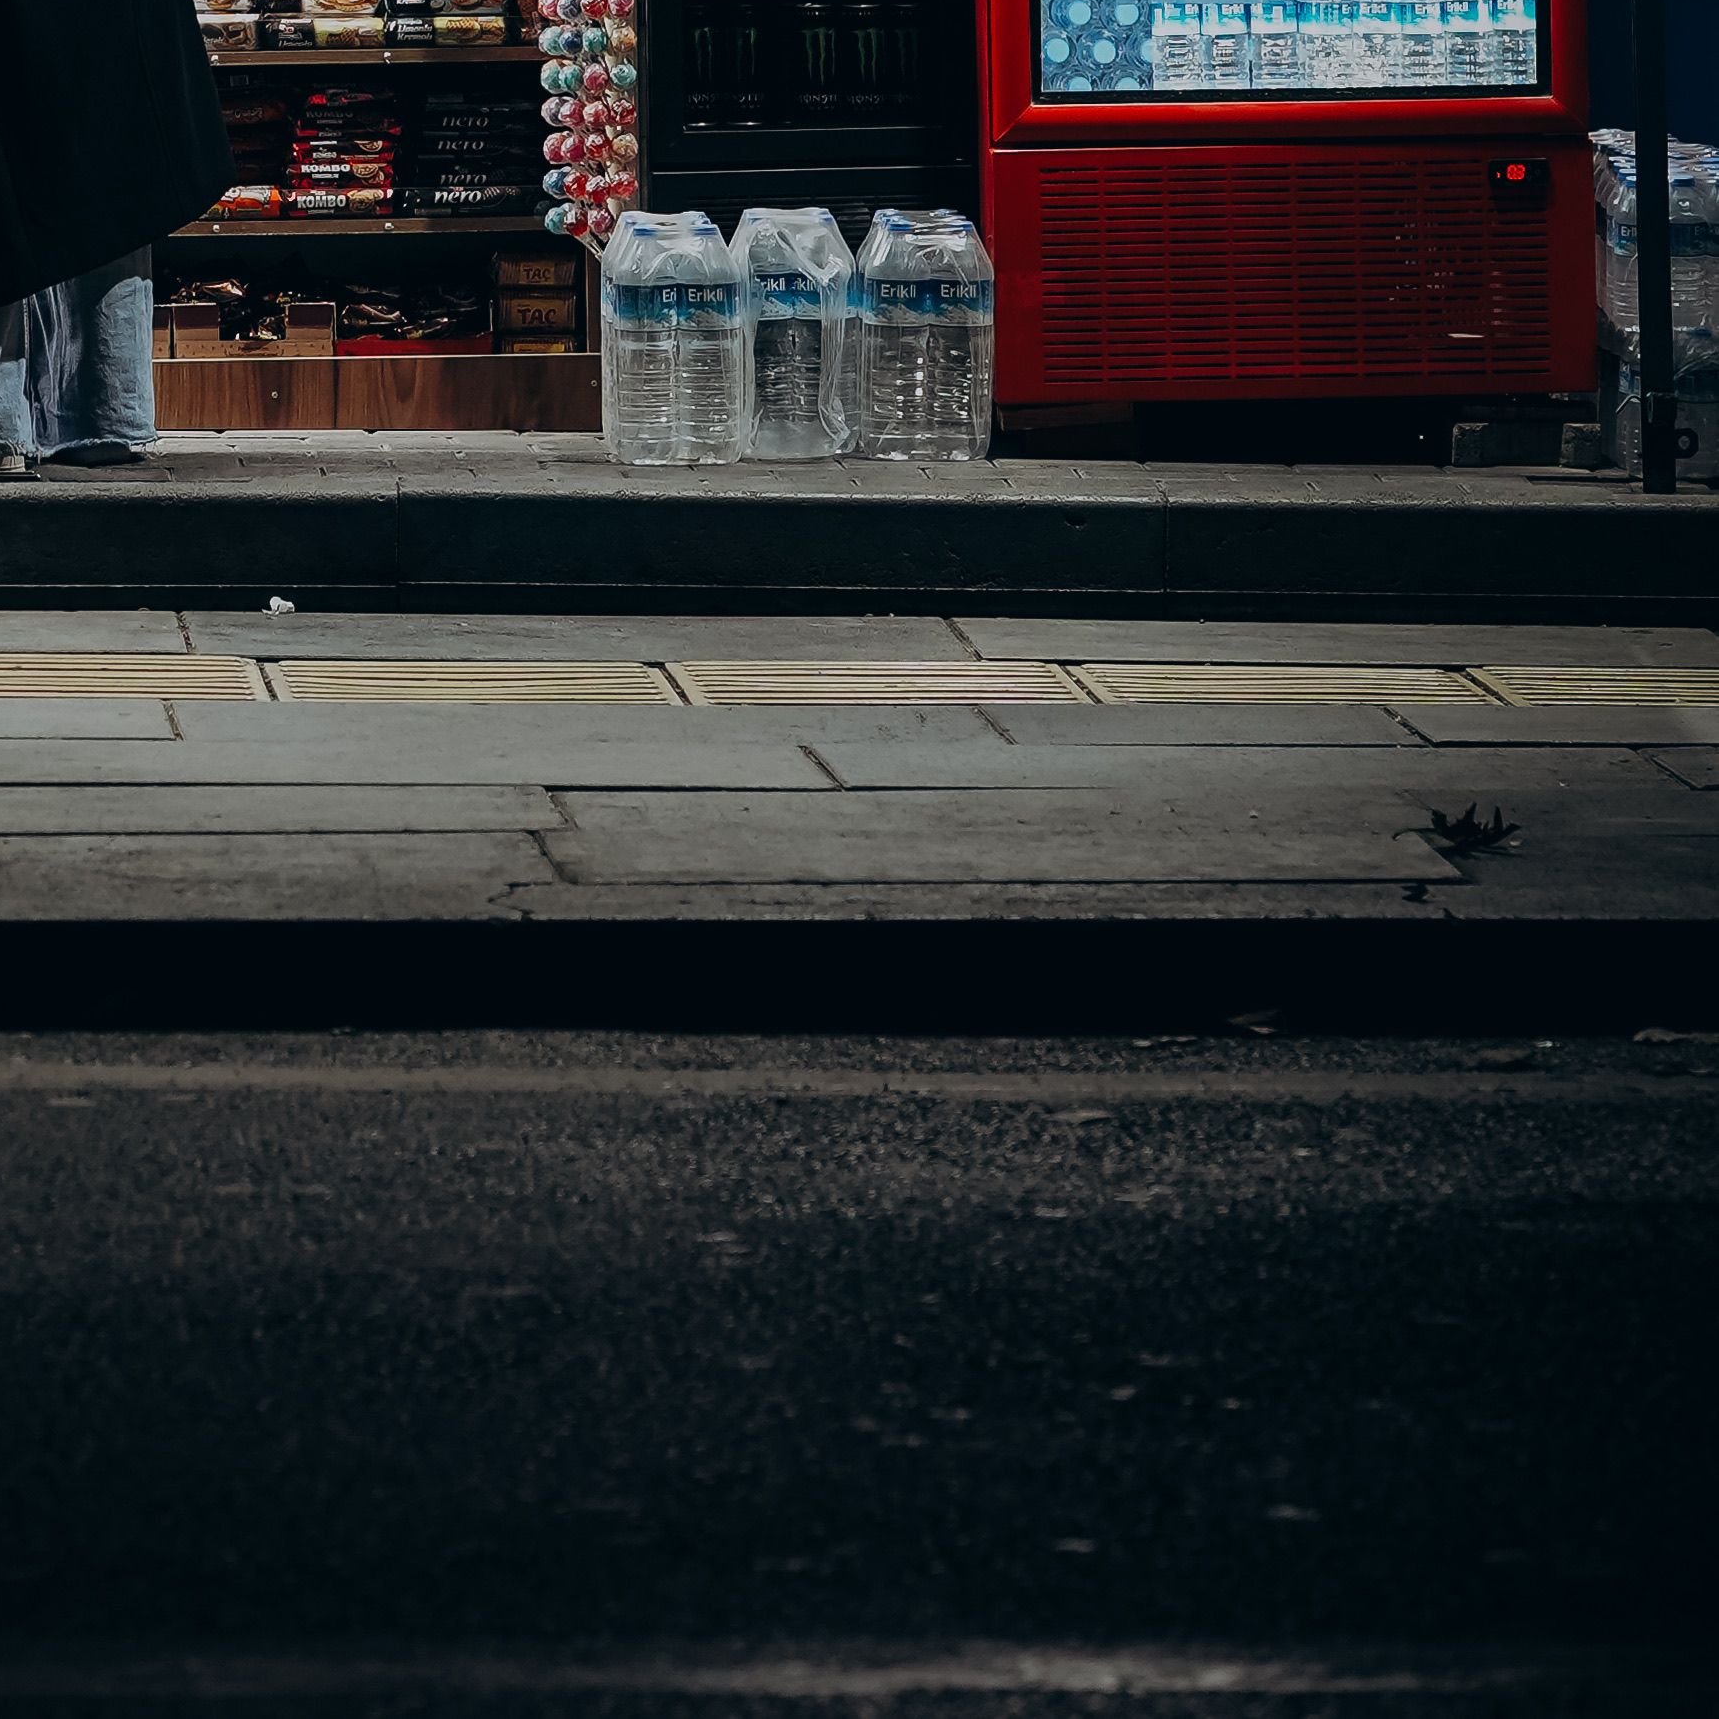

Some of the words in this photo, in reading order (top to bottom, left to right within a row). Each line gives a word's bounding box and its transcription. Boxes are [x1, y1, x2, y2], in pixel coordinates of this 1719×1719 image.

[297, 194, 346, 209] KOMBO
[433, 189, 482, 204] nero
[688, 288, 724, 303] Erikli
[881, 284, 917, 299] Erikli
[940, 283, 977, 299] Erikli
